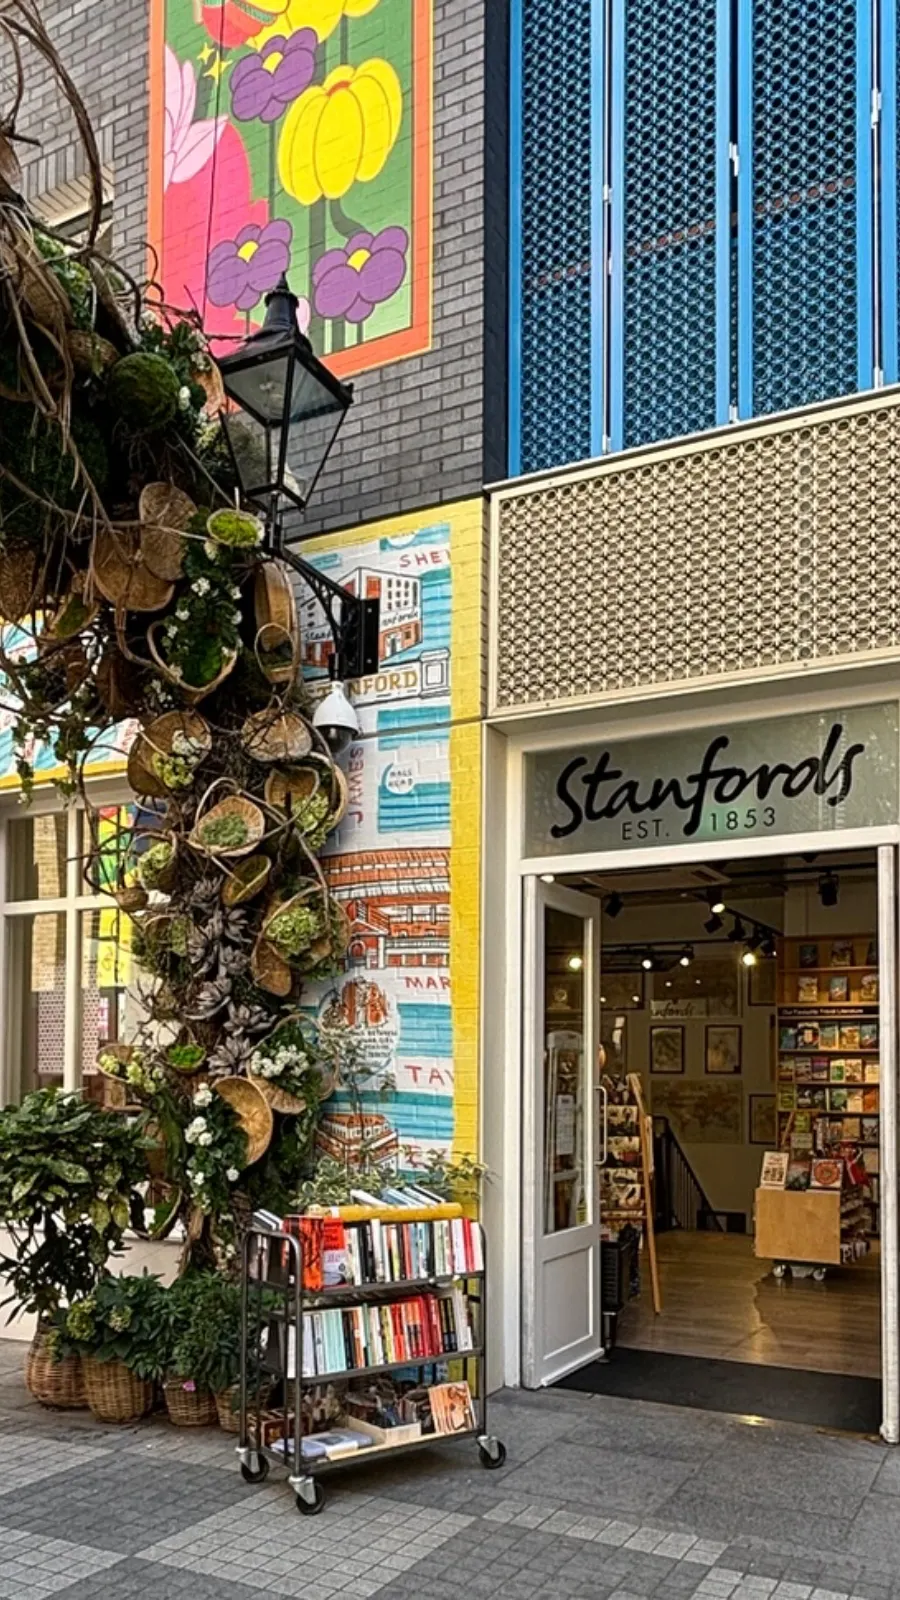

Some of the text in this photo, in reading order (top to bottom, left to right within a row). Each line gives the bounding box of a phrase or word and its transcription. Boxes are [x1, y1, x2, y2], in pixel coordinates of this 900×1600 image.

[307, 670, 418, 698] TNFORD
[347, 747, 364, 824] JAMES
[550, 723, 865, 838] Stanfords
[622, 806, 777, 841] EST. 1853
